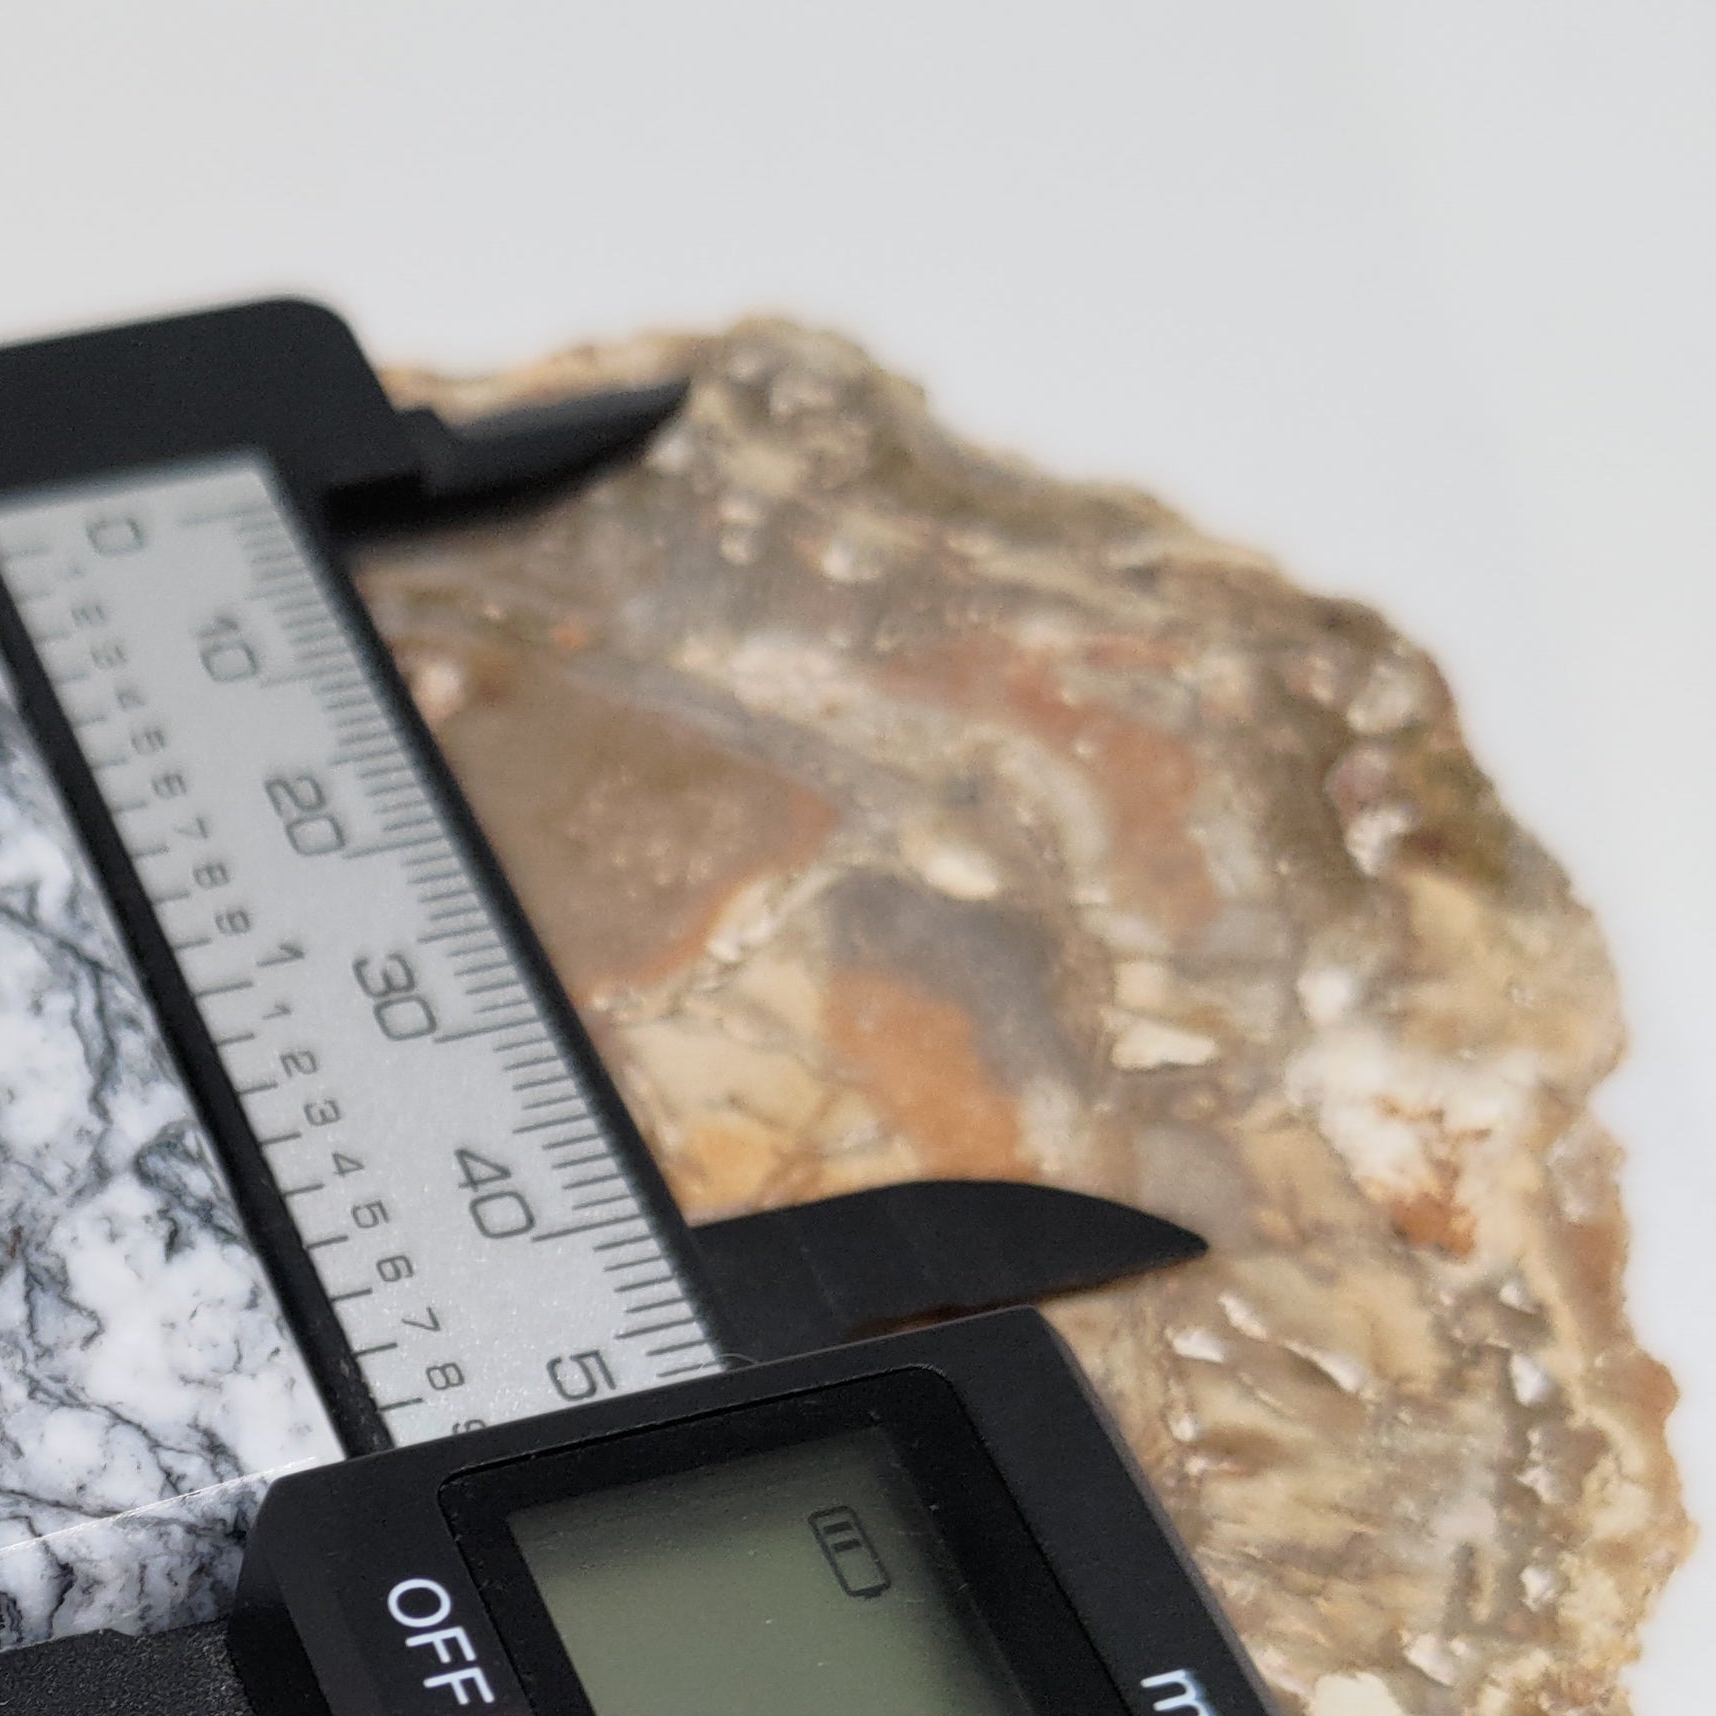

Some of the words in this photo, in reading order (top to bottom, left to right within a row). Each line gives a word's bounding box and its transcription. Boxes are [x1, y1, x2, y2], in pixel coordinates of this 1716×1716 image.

[87, 515, 144, 557] 0
[194, 614, 260, 683] 10
[264, 775, 346, 857] 20
[352, 952, 439, 1042] 30
[454, 1147, 536, 1239] 40
[174, 816, 210, 841] 7
[192, 861, 232, 889] 8
[214, 908, 254, 936] 9
[256, 940, 305, 968] 1
[262, 1002, 293, 1020] 1
[280, 1050, 318, 1076] 2
[304, 1099, 341, 1127] 3
[330, 1152, 365, 1178] 4
[352, 1200, 390, 1229] 5
[376, 1255, 414, 1283] 6
[402, 1307, 441, 1336] 7
[426, 1362, 465, 1391] 8
[387, 1579, 494, 1706] OFF
